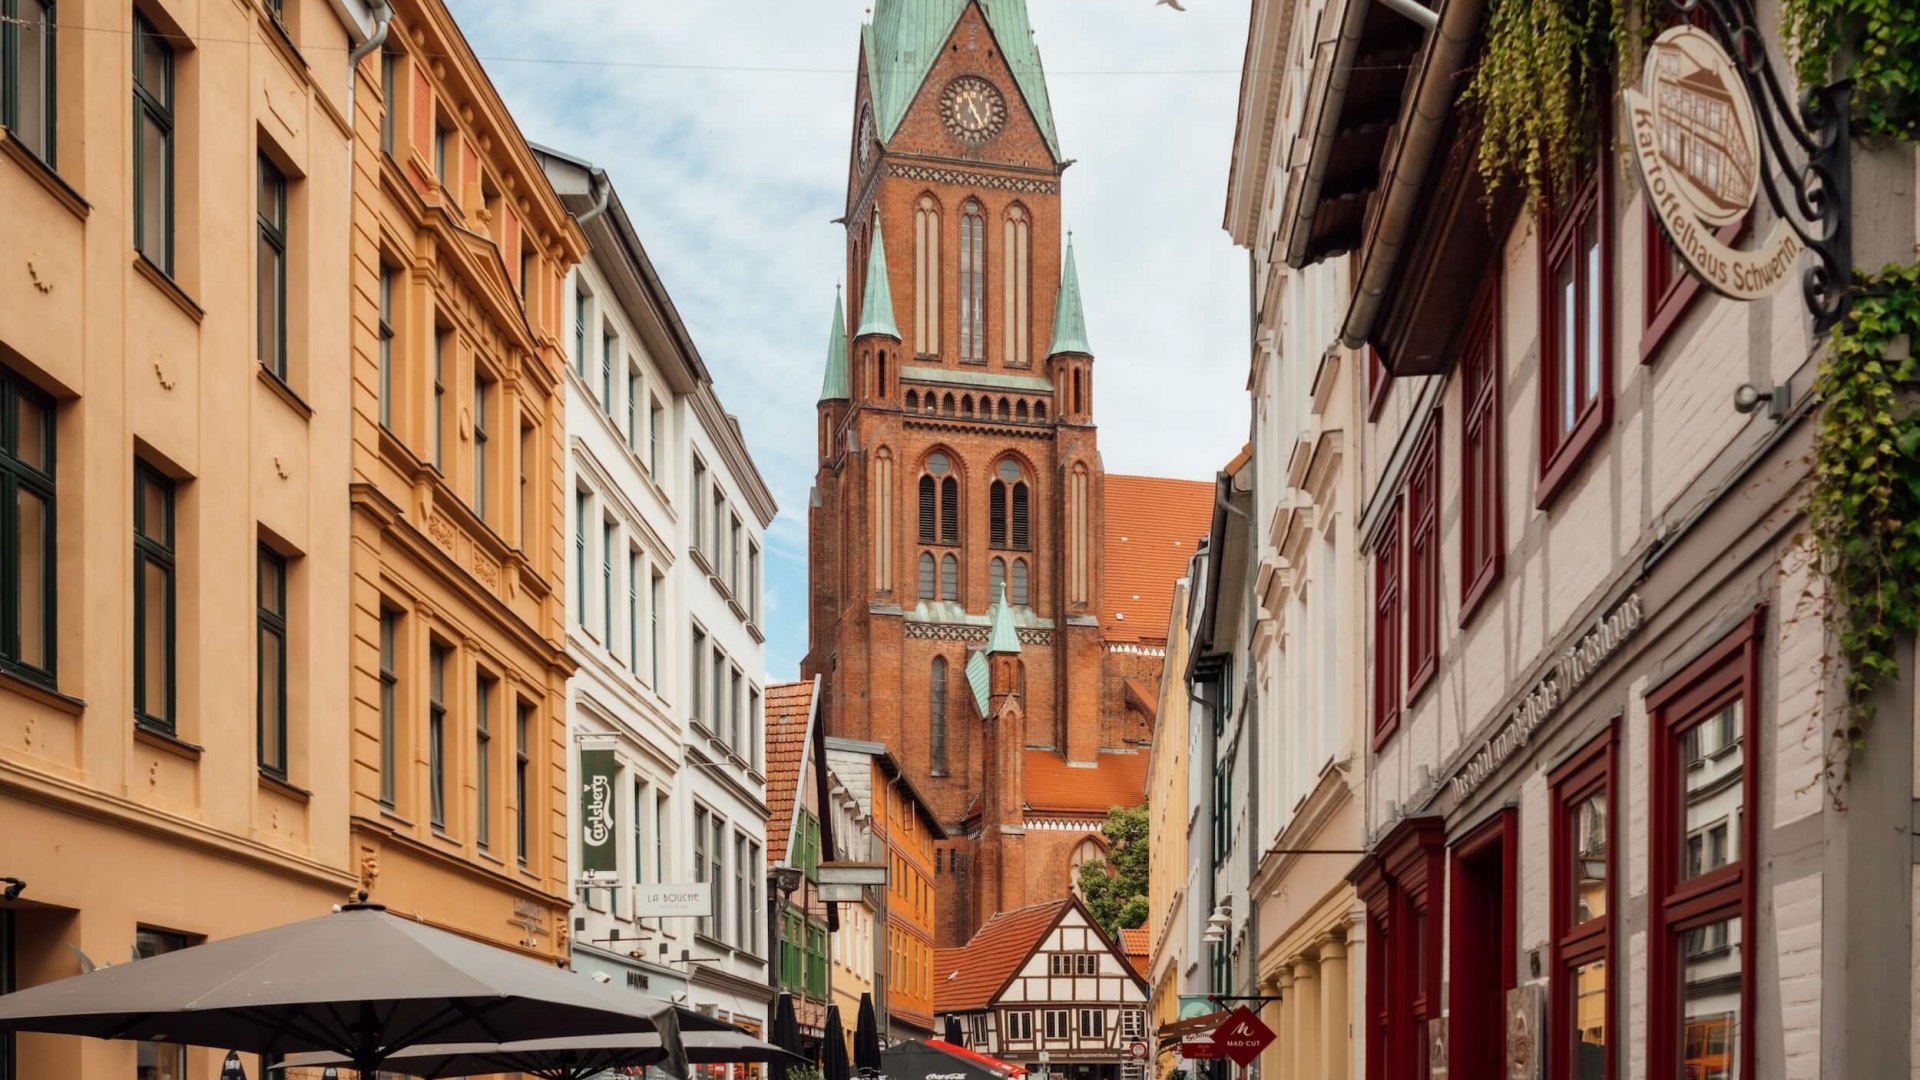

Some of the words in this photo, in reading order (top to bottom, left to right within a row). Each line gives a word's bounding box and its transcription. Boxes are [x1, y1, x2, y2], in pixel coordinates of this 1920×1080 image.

[1634, 107, 1728, 283] Kartoffelhaus
[1732, 236, 1796, 293] Schwerin
[583, 775, 614, 847] Carlsberg
[647, 894, 659, 903] LA
[663, 893, 699, 903] BOUCHE
